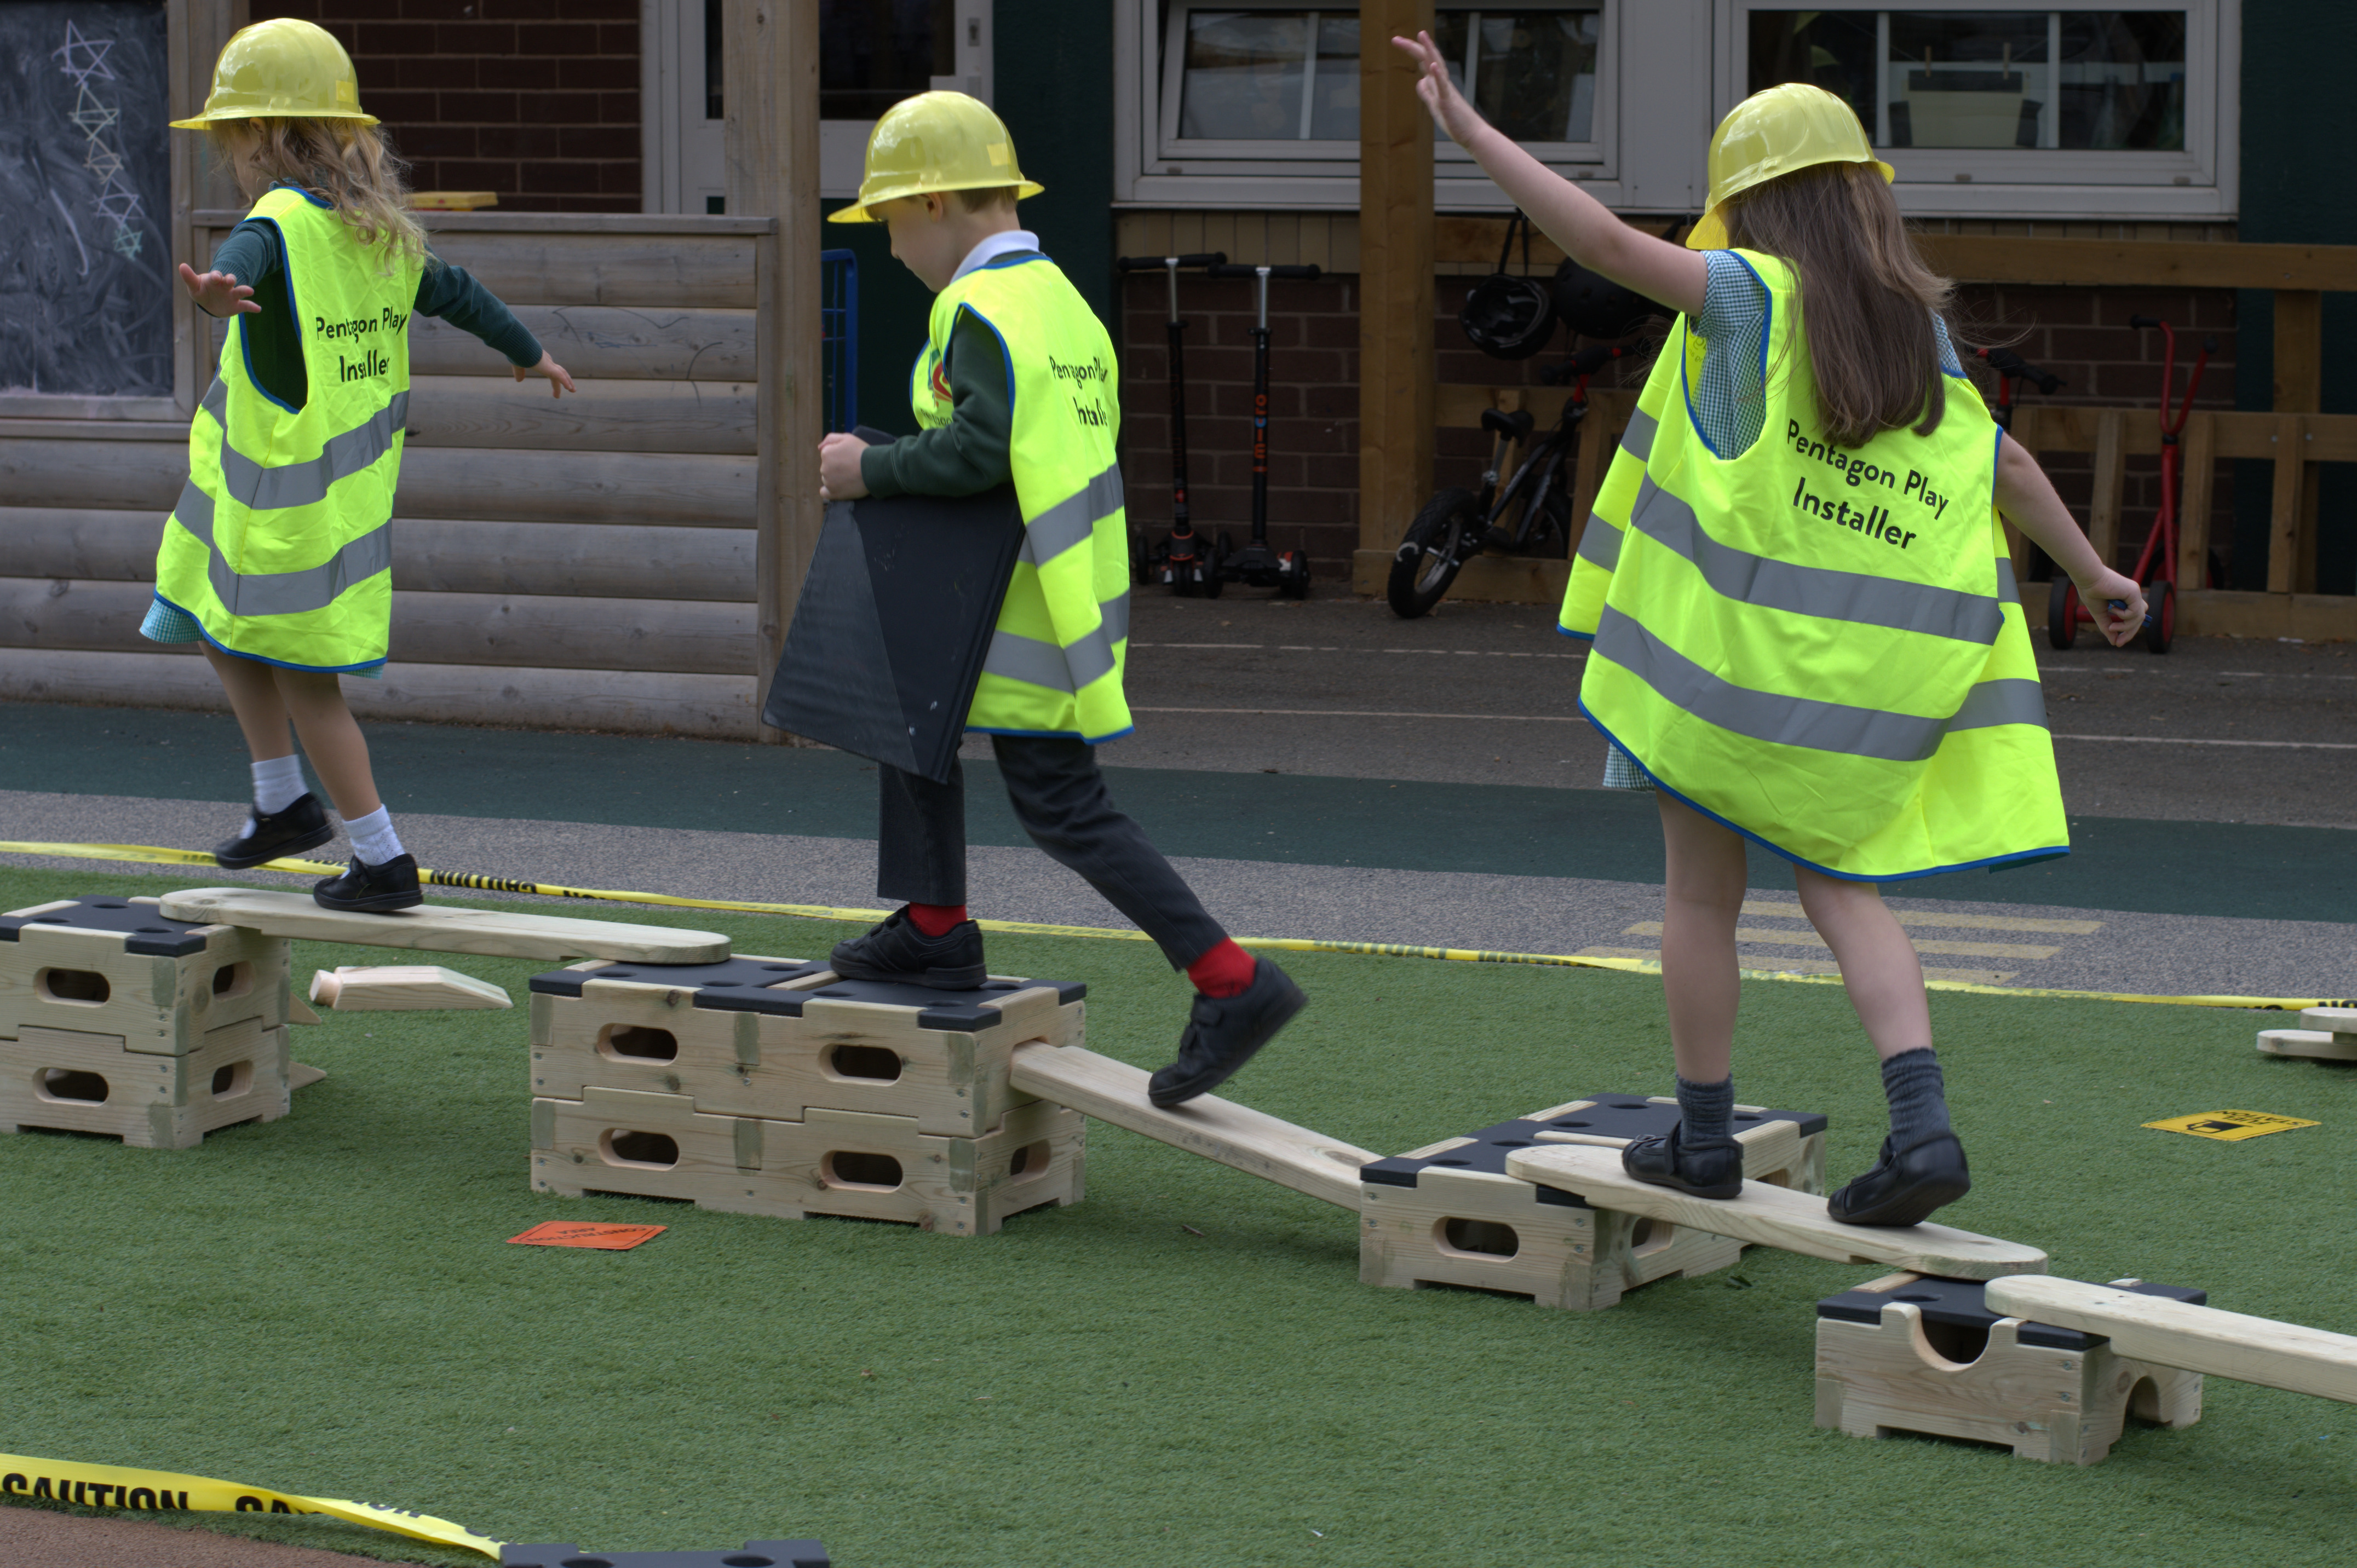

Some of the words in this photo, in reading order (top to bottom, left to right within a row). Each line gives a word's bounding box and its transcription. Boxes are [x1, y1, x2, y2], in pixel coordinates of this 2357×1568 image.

[382, 306, 407, 336] Play
[339, 349, 390, 382] Insaller
[1048, 354, 1096, 390] Penagon
[1787, 418, 1896, 488] Pentagon
[1903, 469, 1950, 521] Play
[1792, 476, 1917, 550] Installer
[2214, 1110, 2306, 1126] STATION
[2222, 1115, 2272, 1125] FUEL
[526, 1226, 647, 1242] CONSTRUCTION
[2, 1472, 188, 1509] CAUTION
